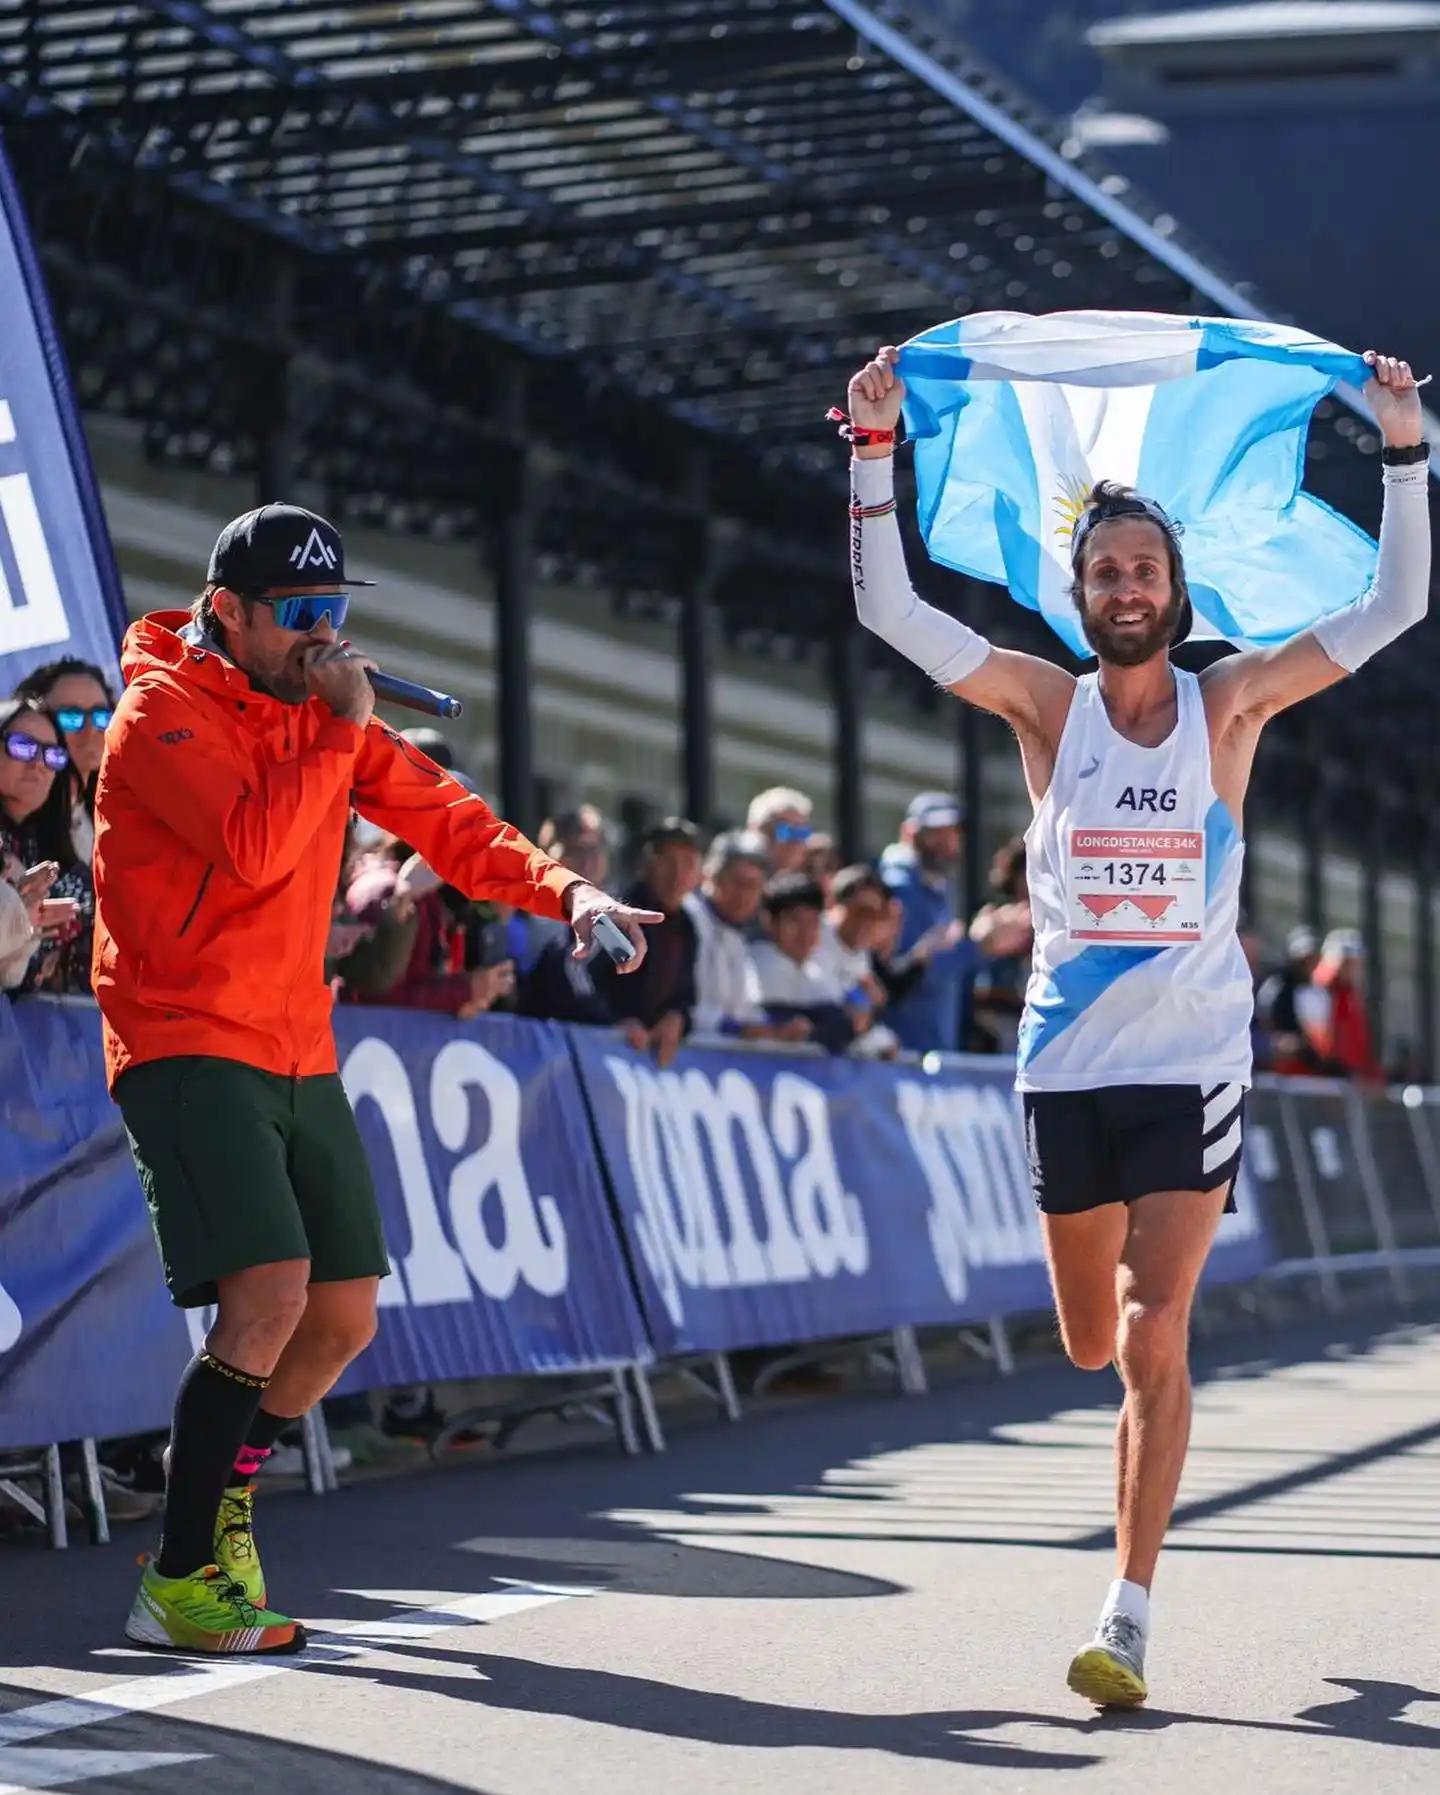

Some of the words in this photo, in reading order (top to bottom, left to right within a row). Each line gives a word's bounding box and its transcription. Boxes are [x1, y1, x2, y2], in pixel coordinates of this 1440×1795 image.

[1115, 786, 1177, 812] ARG
[1077, 836, 1171, 849] LONGDISTANCE
[1173, 838, 1197, 849] 34K
[1104, 862, 1166, 885] 1374
